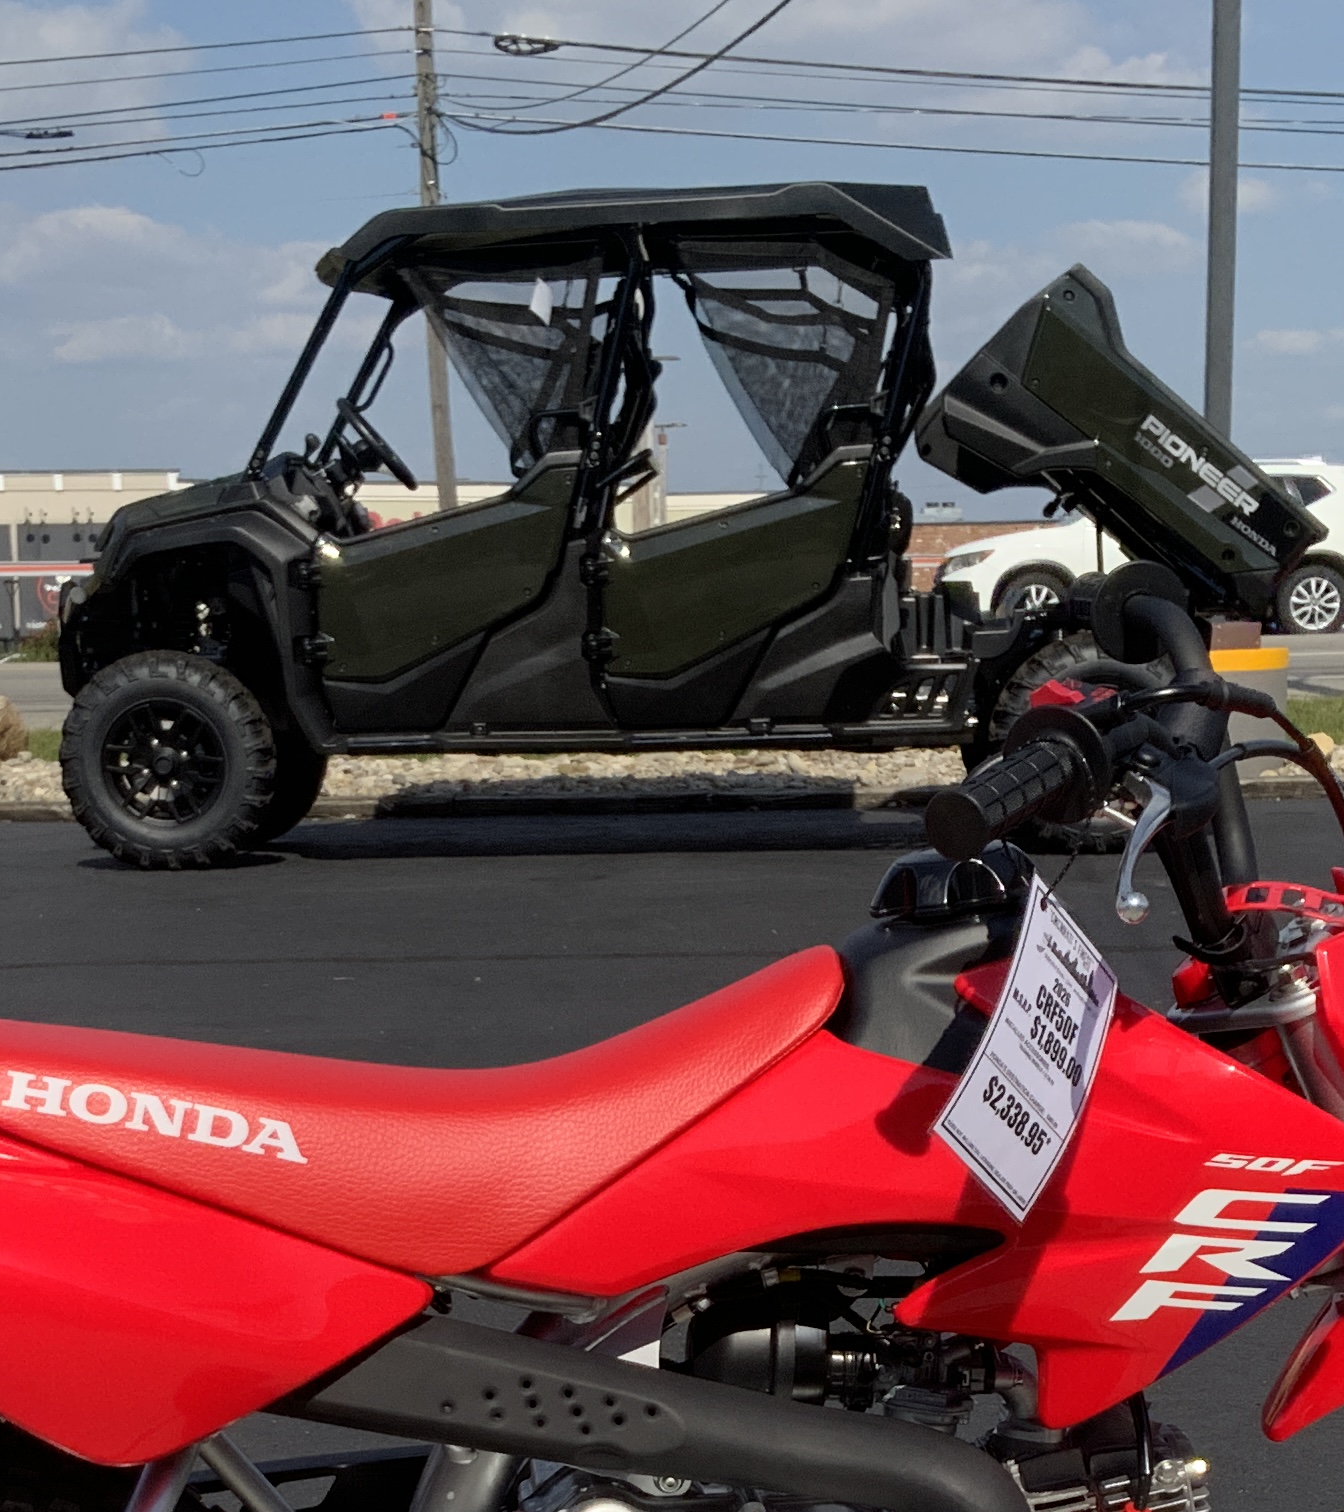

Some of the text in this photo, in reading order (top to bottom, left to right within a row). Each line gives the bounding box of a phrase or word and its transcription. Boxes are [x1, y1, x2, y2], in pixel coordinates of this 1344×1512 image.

[1133, 432, 1175, 469] 1000
[1140, 413, 1260, 516] PIONEER
[1230, 515, 1277, 557] HONDA
[1031, 1015, 1083, 1088] $1,899.00
[1036, 984, 1080, 1048] CRF50F
[2, 1070, 308, 1164] HONDA
[1109, 1188, 1331, 1321] CRF
